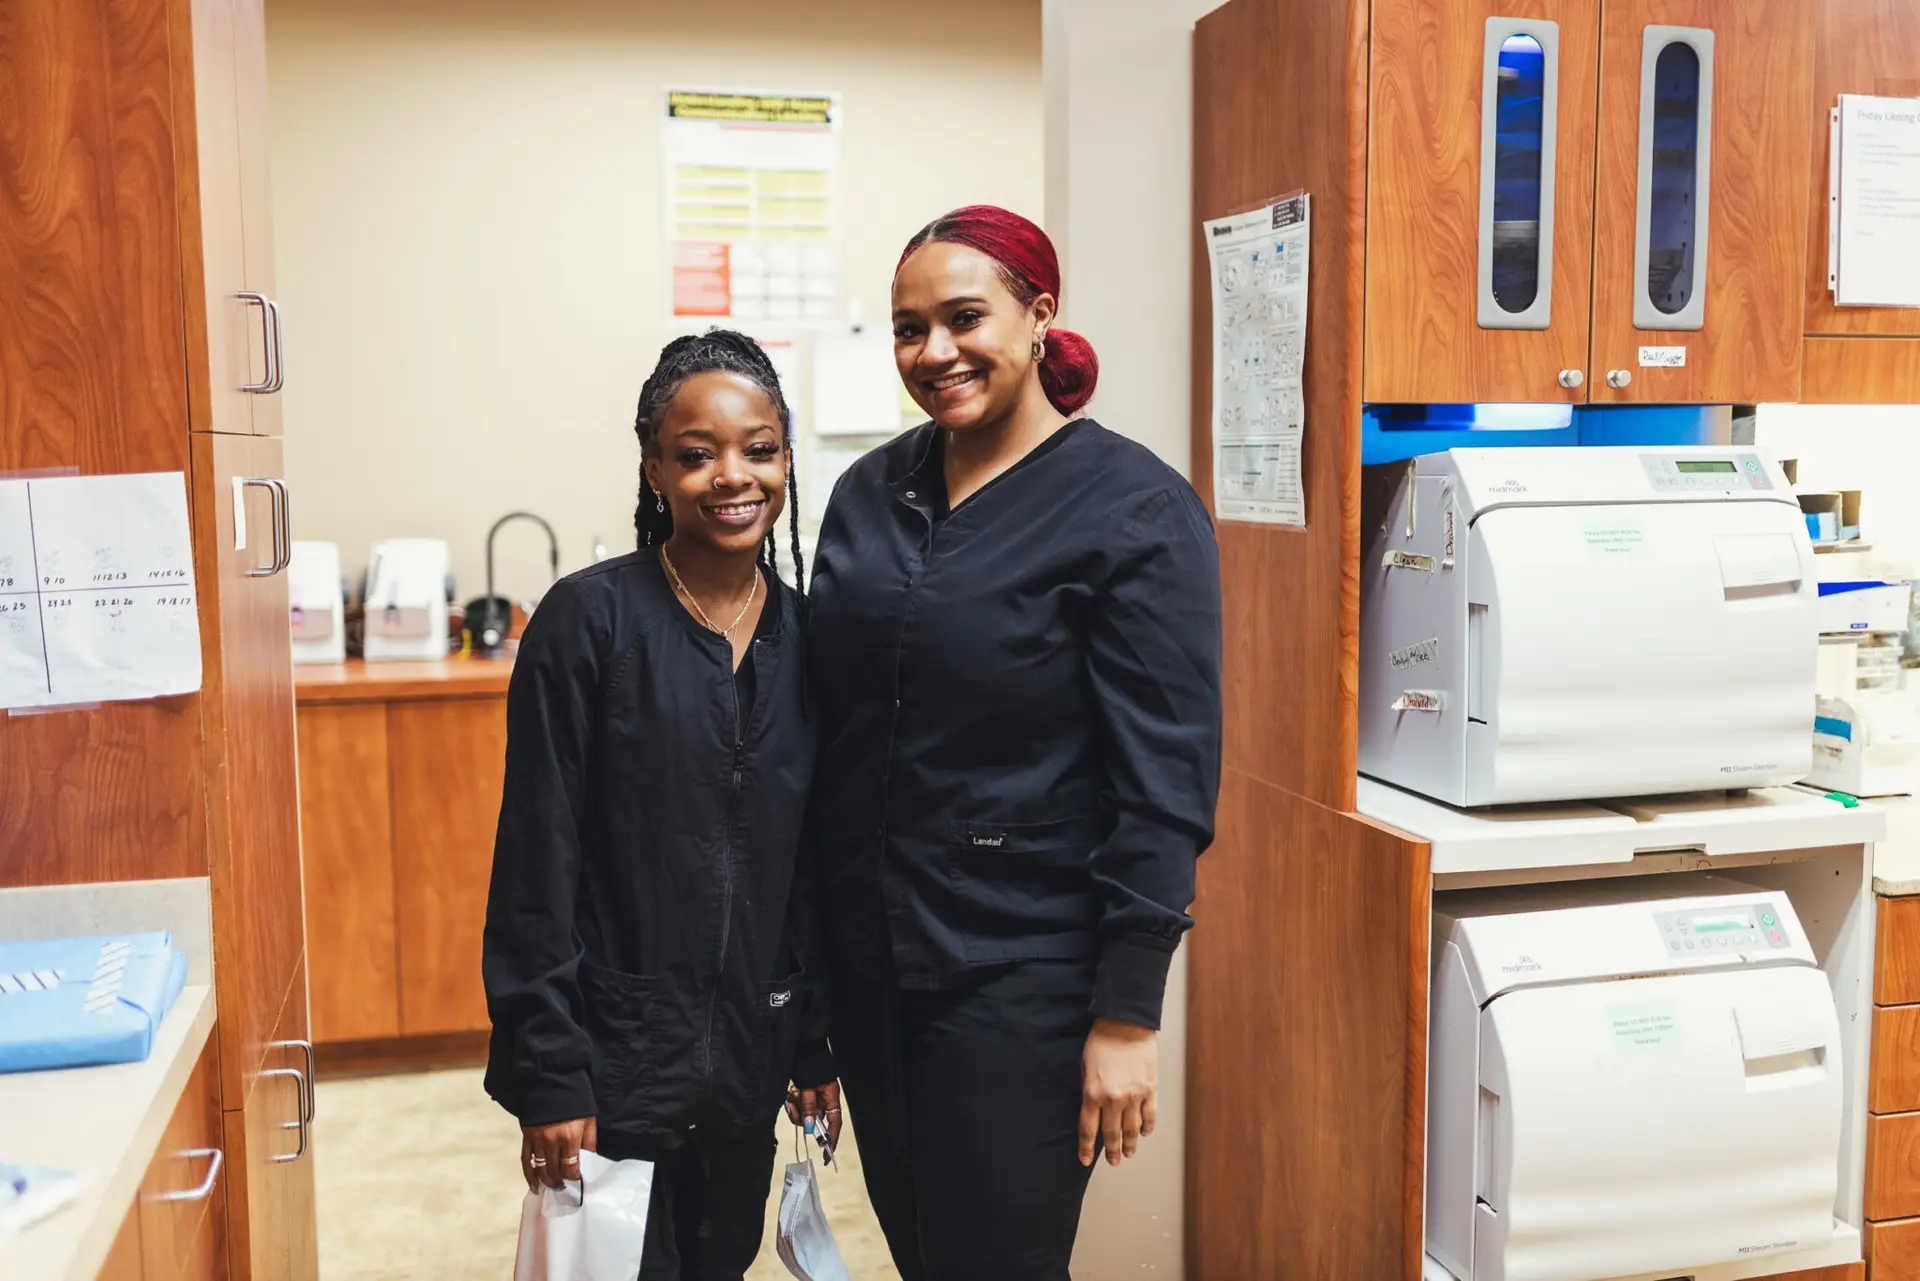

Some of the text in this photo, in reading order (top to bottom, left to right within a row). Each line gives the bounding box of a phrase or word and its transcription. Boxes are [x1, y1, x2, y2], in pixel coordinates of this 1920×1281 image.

[7, 578, 14, 586] 8
[44, 576, 50, 585] 9
[103, 573, 113, 581] 12
[116, 571, 127, 580] 13
[174, 569, 185, 577] 16
[124, 598, 134, 606] 20
[157, 597, 167, 605] 19
[180, 597, 191, 605] 17
[1501, 962, 1542, 973] midmark
